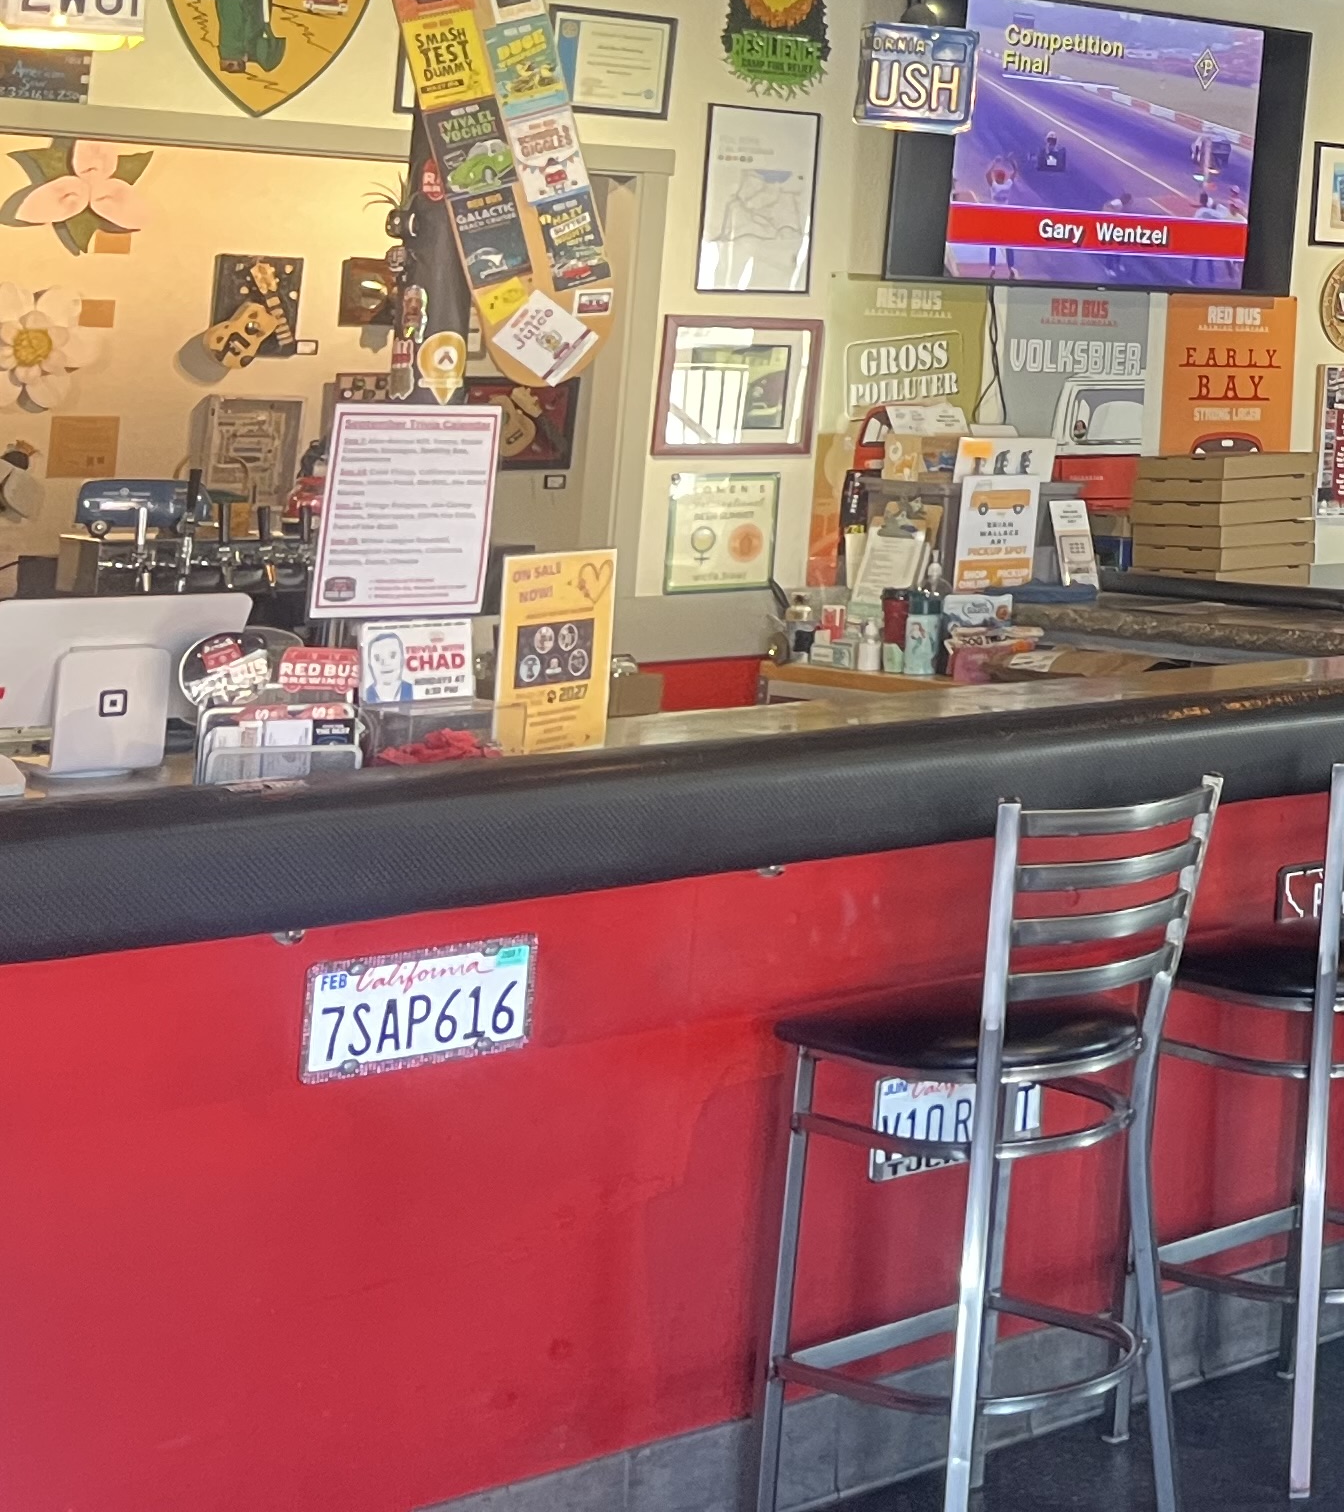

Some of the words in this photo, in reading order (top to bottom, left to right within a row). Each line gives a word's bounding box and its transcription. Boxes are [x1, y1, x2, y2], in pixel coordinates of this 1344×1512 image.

[415, 26, 467, 48] SMASH
[732, 35, 823, 62] RESILIENCE
[1004, 23, 1125, 58] Competition
[418, 40, 470, 69] TEST
[1002, 50, 1051, 75] Final
[423, 59, 474, 82] DUMMY
[456, 202, 515, 225] GALACTIC
[1038, 219, 1084, 244] Gary
[1096, 221, 1169, 245] Wentzel
[876, 287, 908, 309] RED
[910, 289, 943, 310] BUS
[1051, 298, 1079, 319] RED
[1081, 299, 1110, 320] BUS
[1207, 305, 1234, 325] RED
[1235, 306, 1262, 326] BUS
[860, 339, 949, 378] GROSS
[1009, 338, 1143, 376] VOLKSBIER
[1184, 346, 1279, 368] EARLY
[850, 371, 959, 408] POLLUTER
[1196, 374, 1266, 400] BAY
[512, 567, 531, 584] ON
[279, 662, 321, 677] RED
[405, 652, 466, 672] CHAD
[320, 973, 348, 992] FEB
[355, 958, 494, 994] California
[321, 980, 518, 1062] 7SAP616
[884, 1081, 908, 1096] JUN
